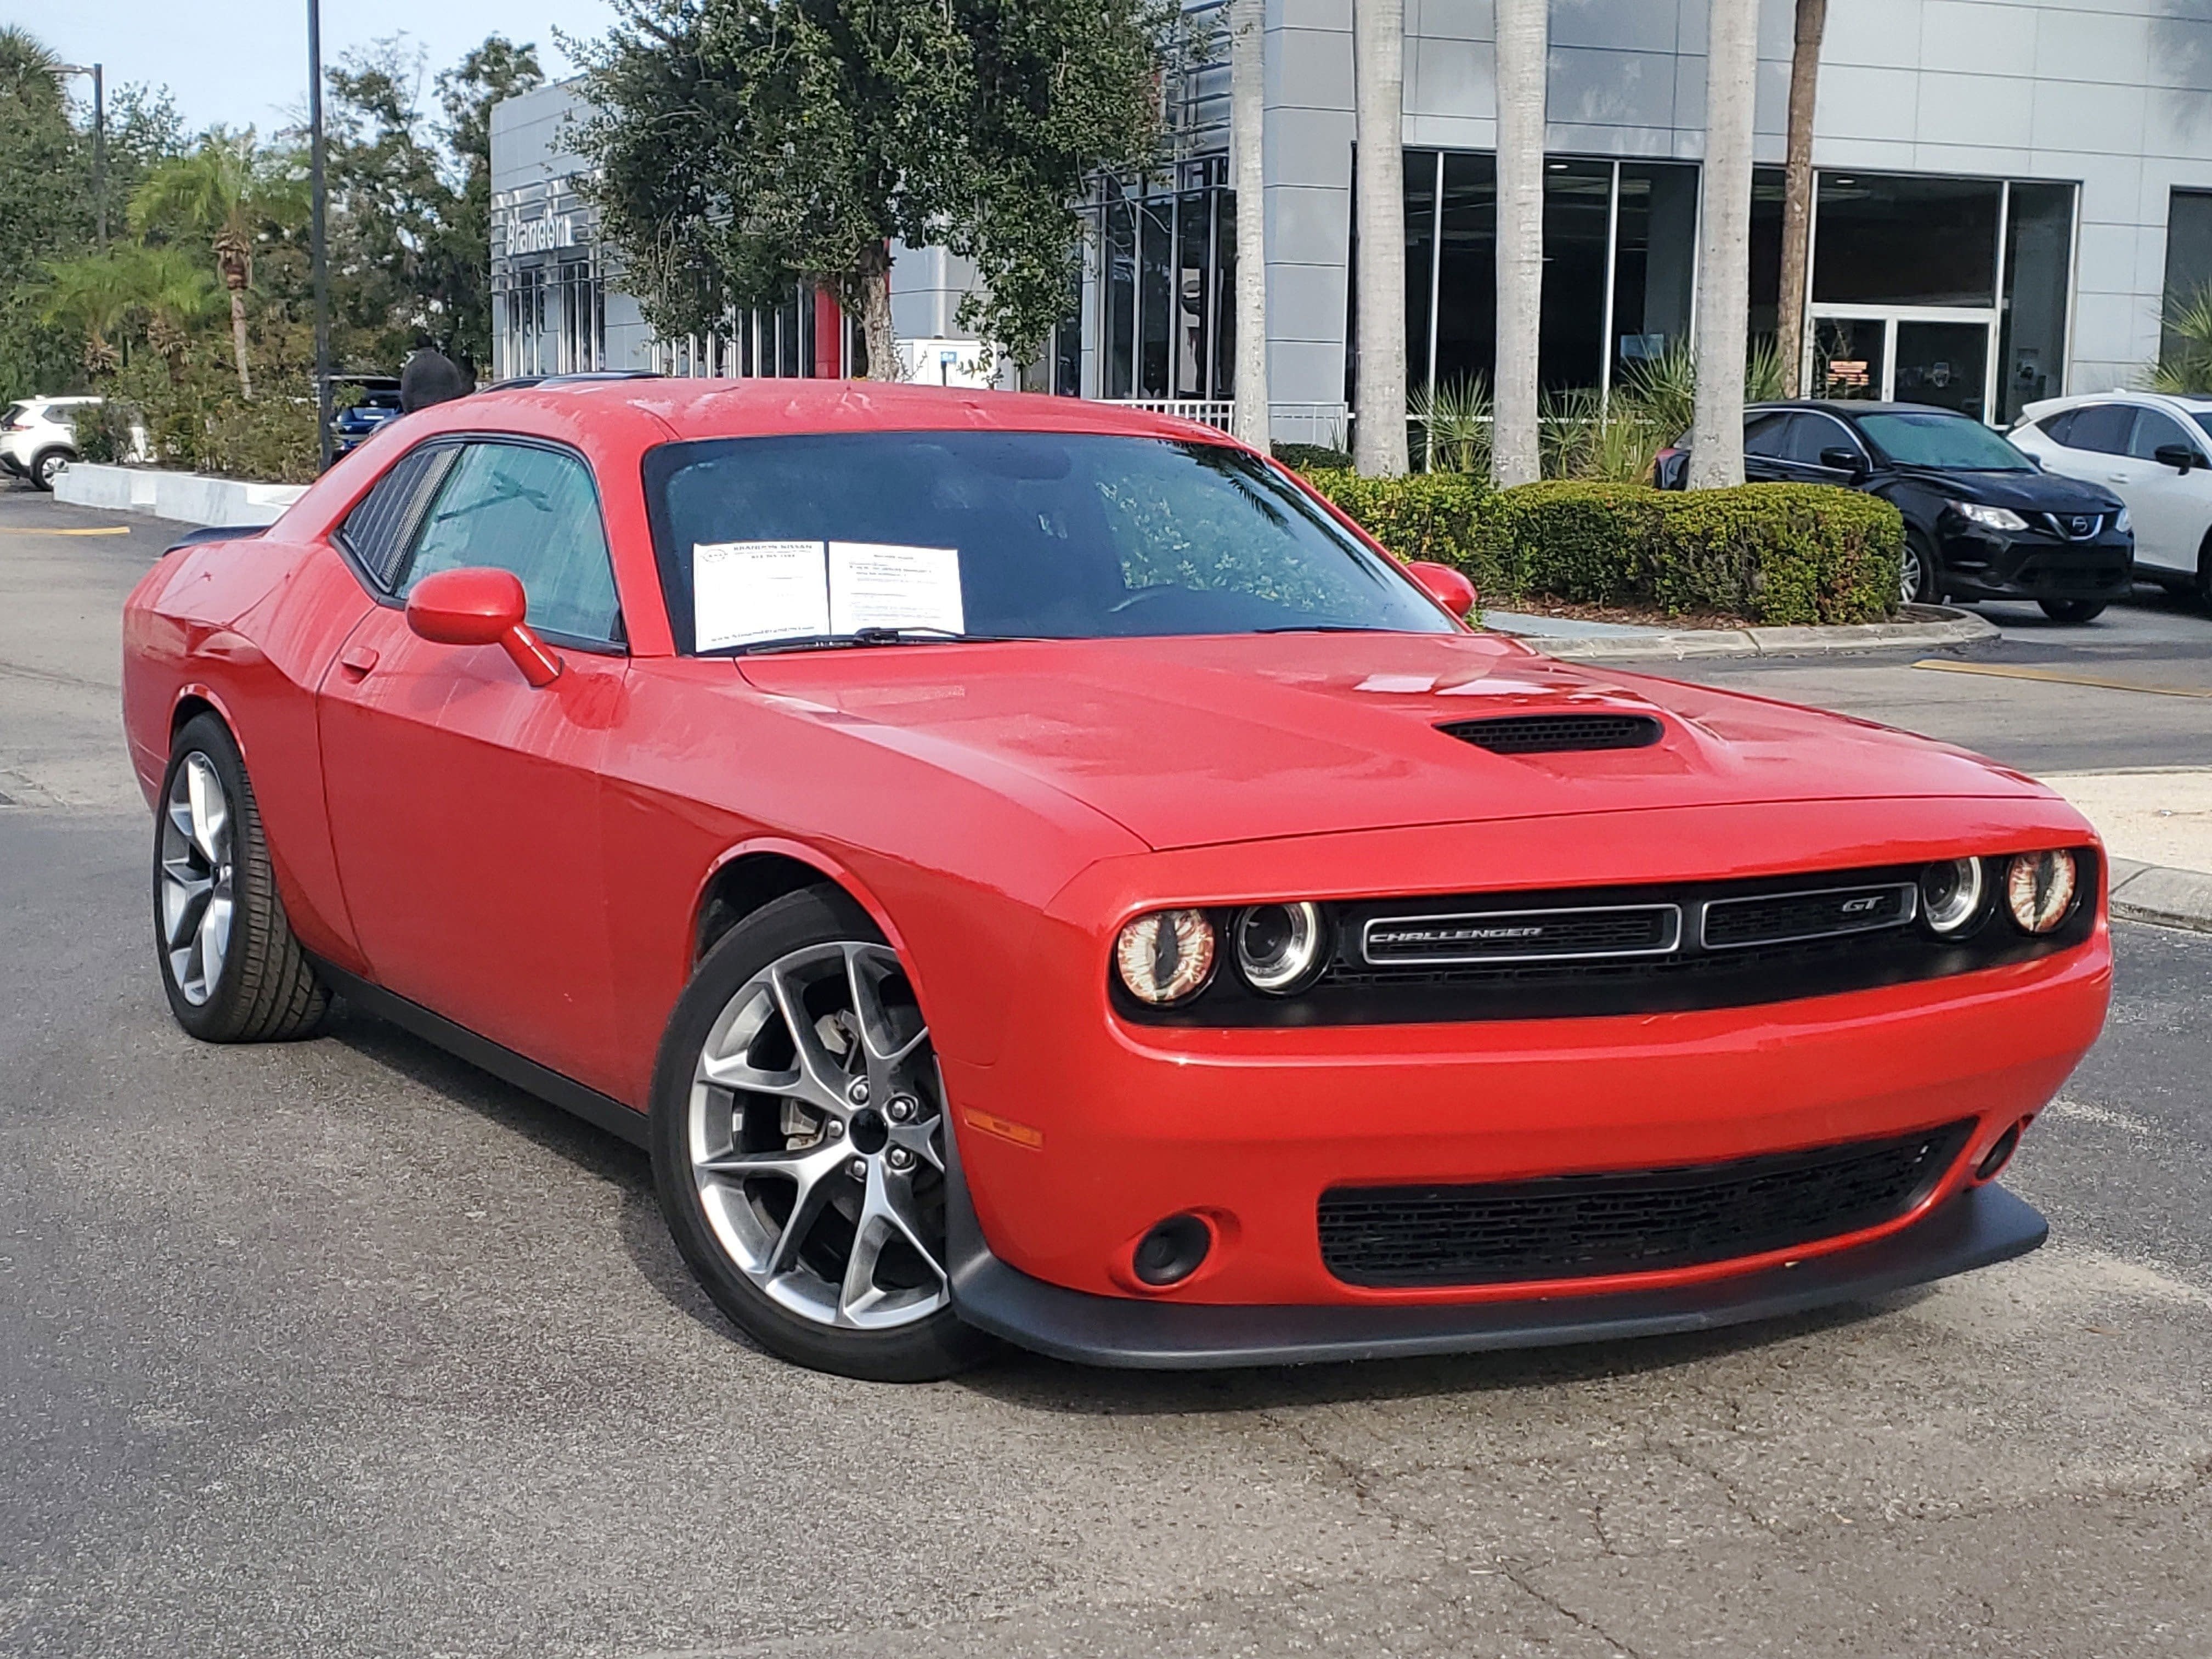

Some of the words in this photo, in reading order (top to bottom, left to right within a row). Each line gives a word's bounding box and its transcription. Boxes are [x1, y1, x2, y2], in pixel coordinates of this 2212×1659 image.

[506, 209, 565, 256] Brandon
[1842, 895, 1884, 912] GT
[1369, 927, 1543, 943] CHALLENGER
